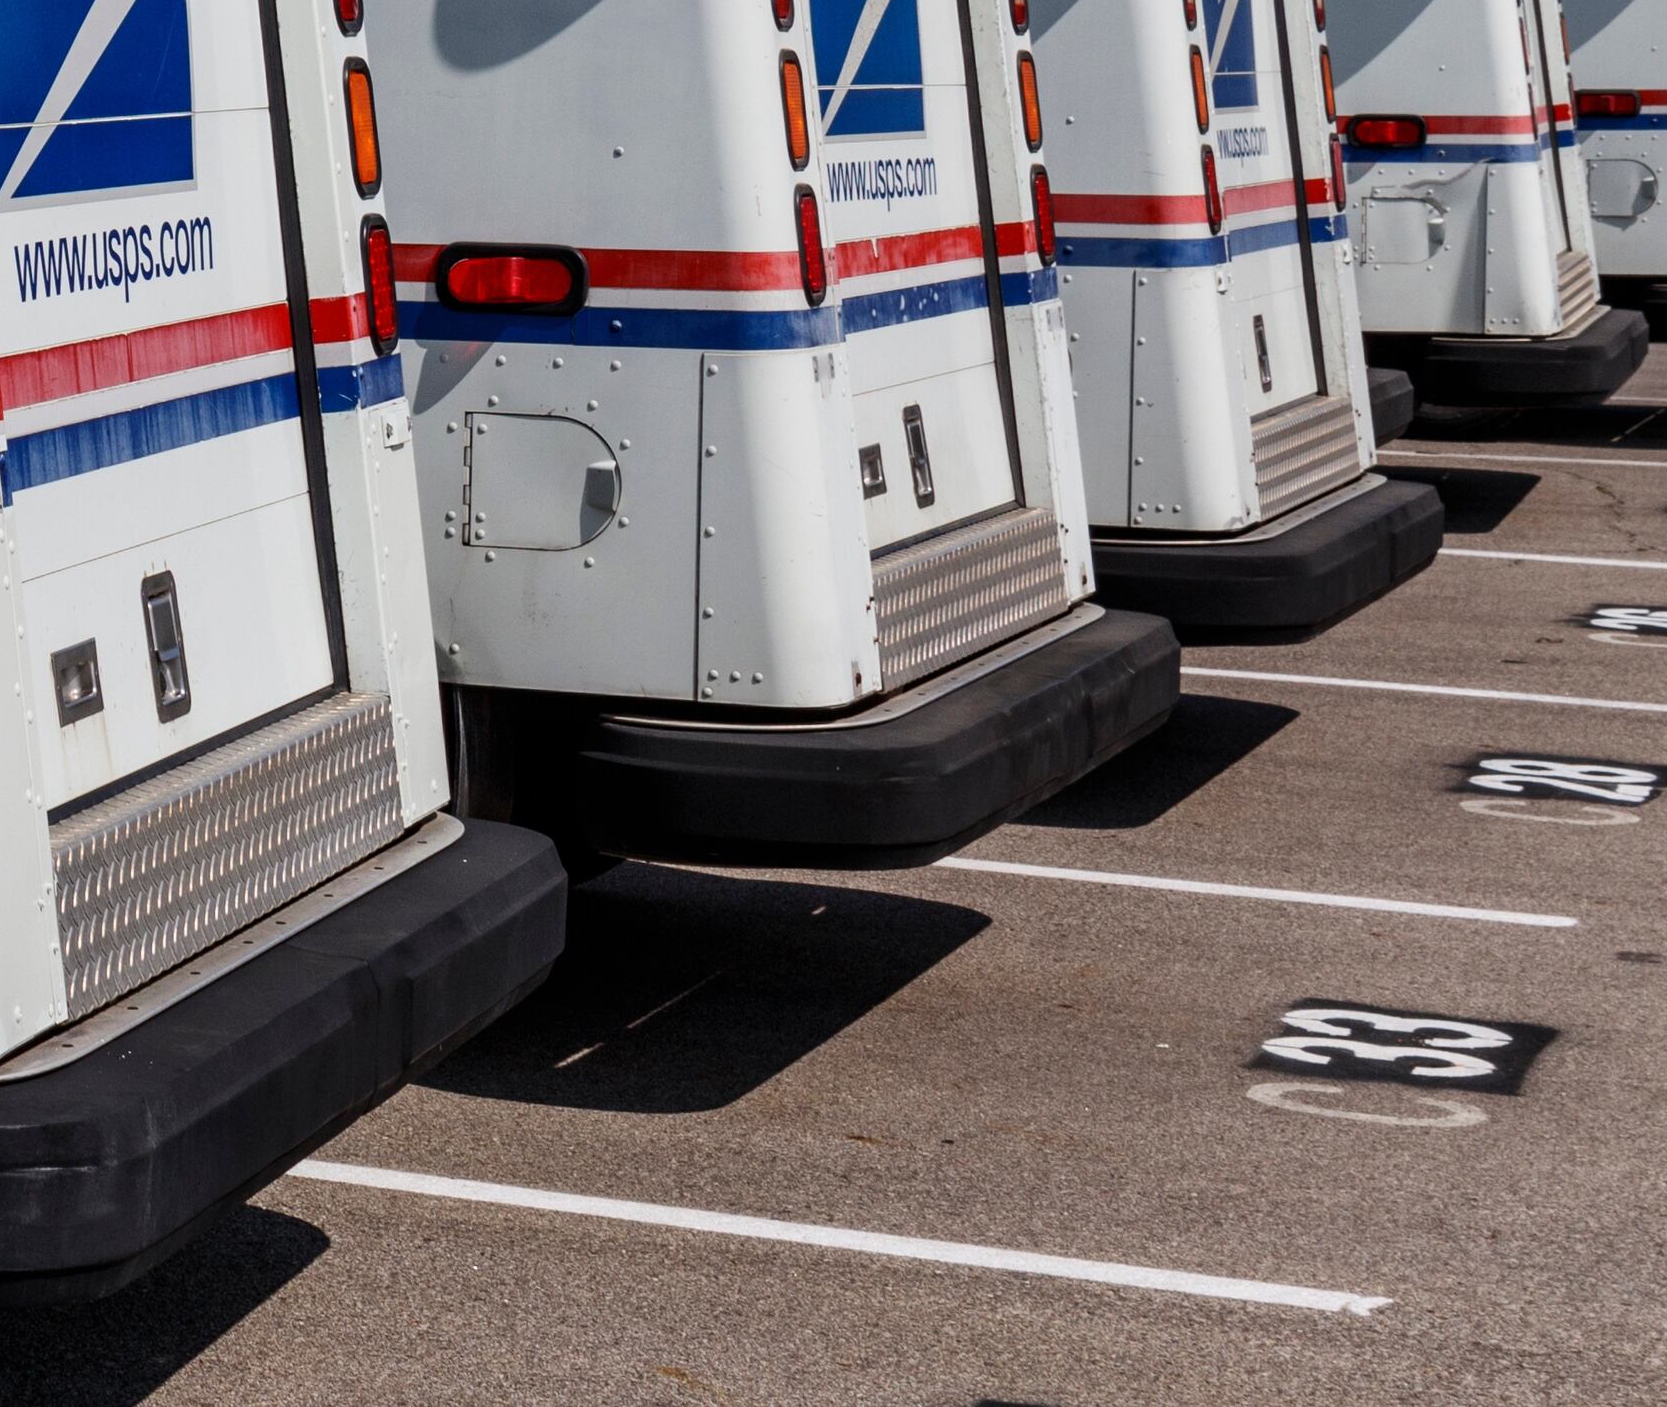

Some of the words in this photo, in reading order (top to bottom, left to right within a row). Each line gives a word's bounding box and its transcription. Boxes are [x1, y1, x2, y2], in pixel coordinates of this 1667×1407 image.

[826, 156, 938, 212] www.usps.com
[14, 216, 213, 303] www.usps.com
[1469, 759, 1656, 802] 28
[1261, 1009, 1514, 1078] 33
